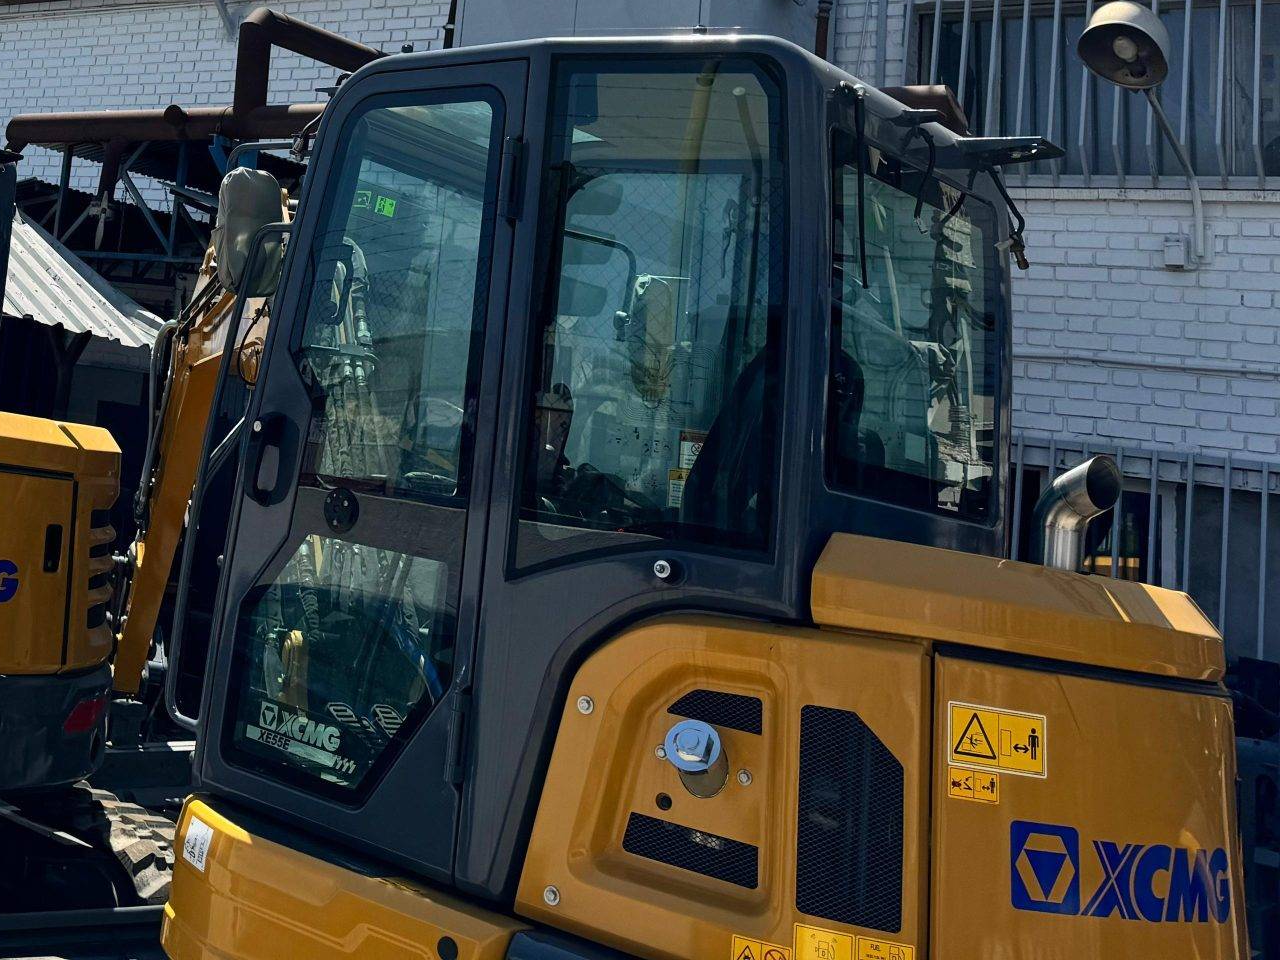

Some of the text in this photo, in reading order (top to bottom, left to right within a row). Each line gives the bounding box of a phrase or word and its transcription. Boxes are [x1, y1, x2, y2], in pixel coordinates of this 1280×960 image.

[258, 730, 291, 751] XE55E
[276, 710, 341, 752] XCMG
[1080, 840, 1231, 924] XCMG
